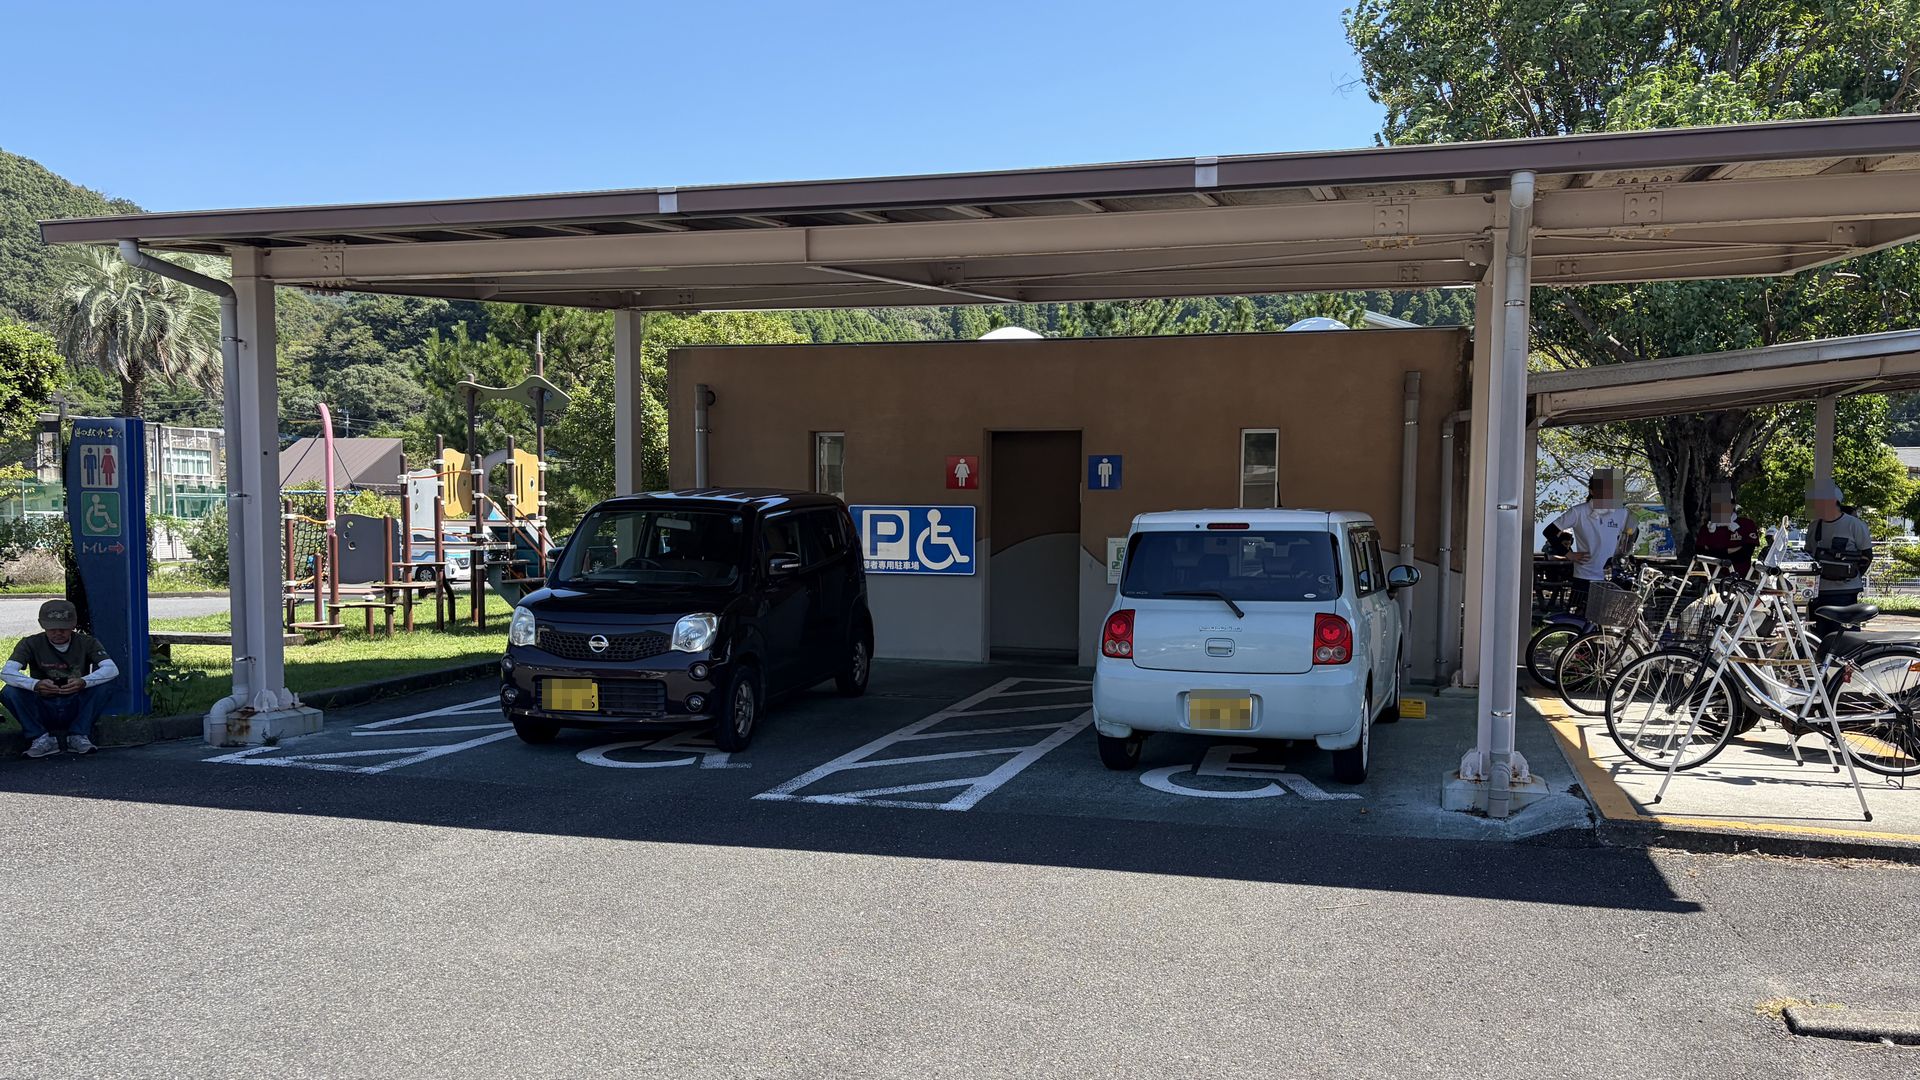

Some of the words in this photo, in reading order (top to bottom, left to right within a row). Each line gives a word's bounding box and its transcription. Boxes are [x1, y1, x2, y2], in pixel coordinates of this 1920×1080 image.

[82, 541, 108, 553] トイレ
[869, 513, 904, 556] P
